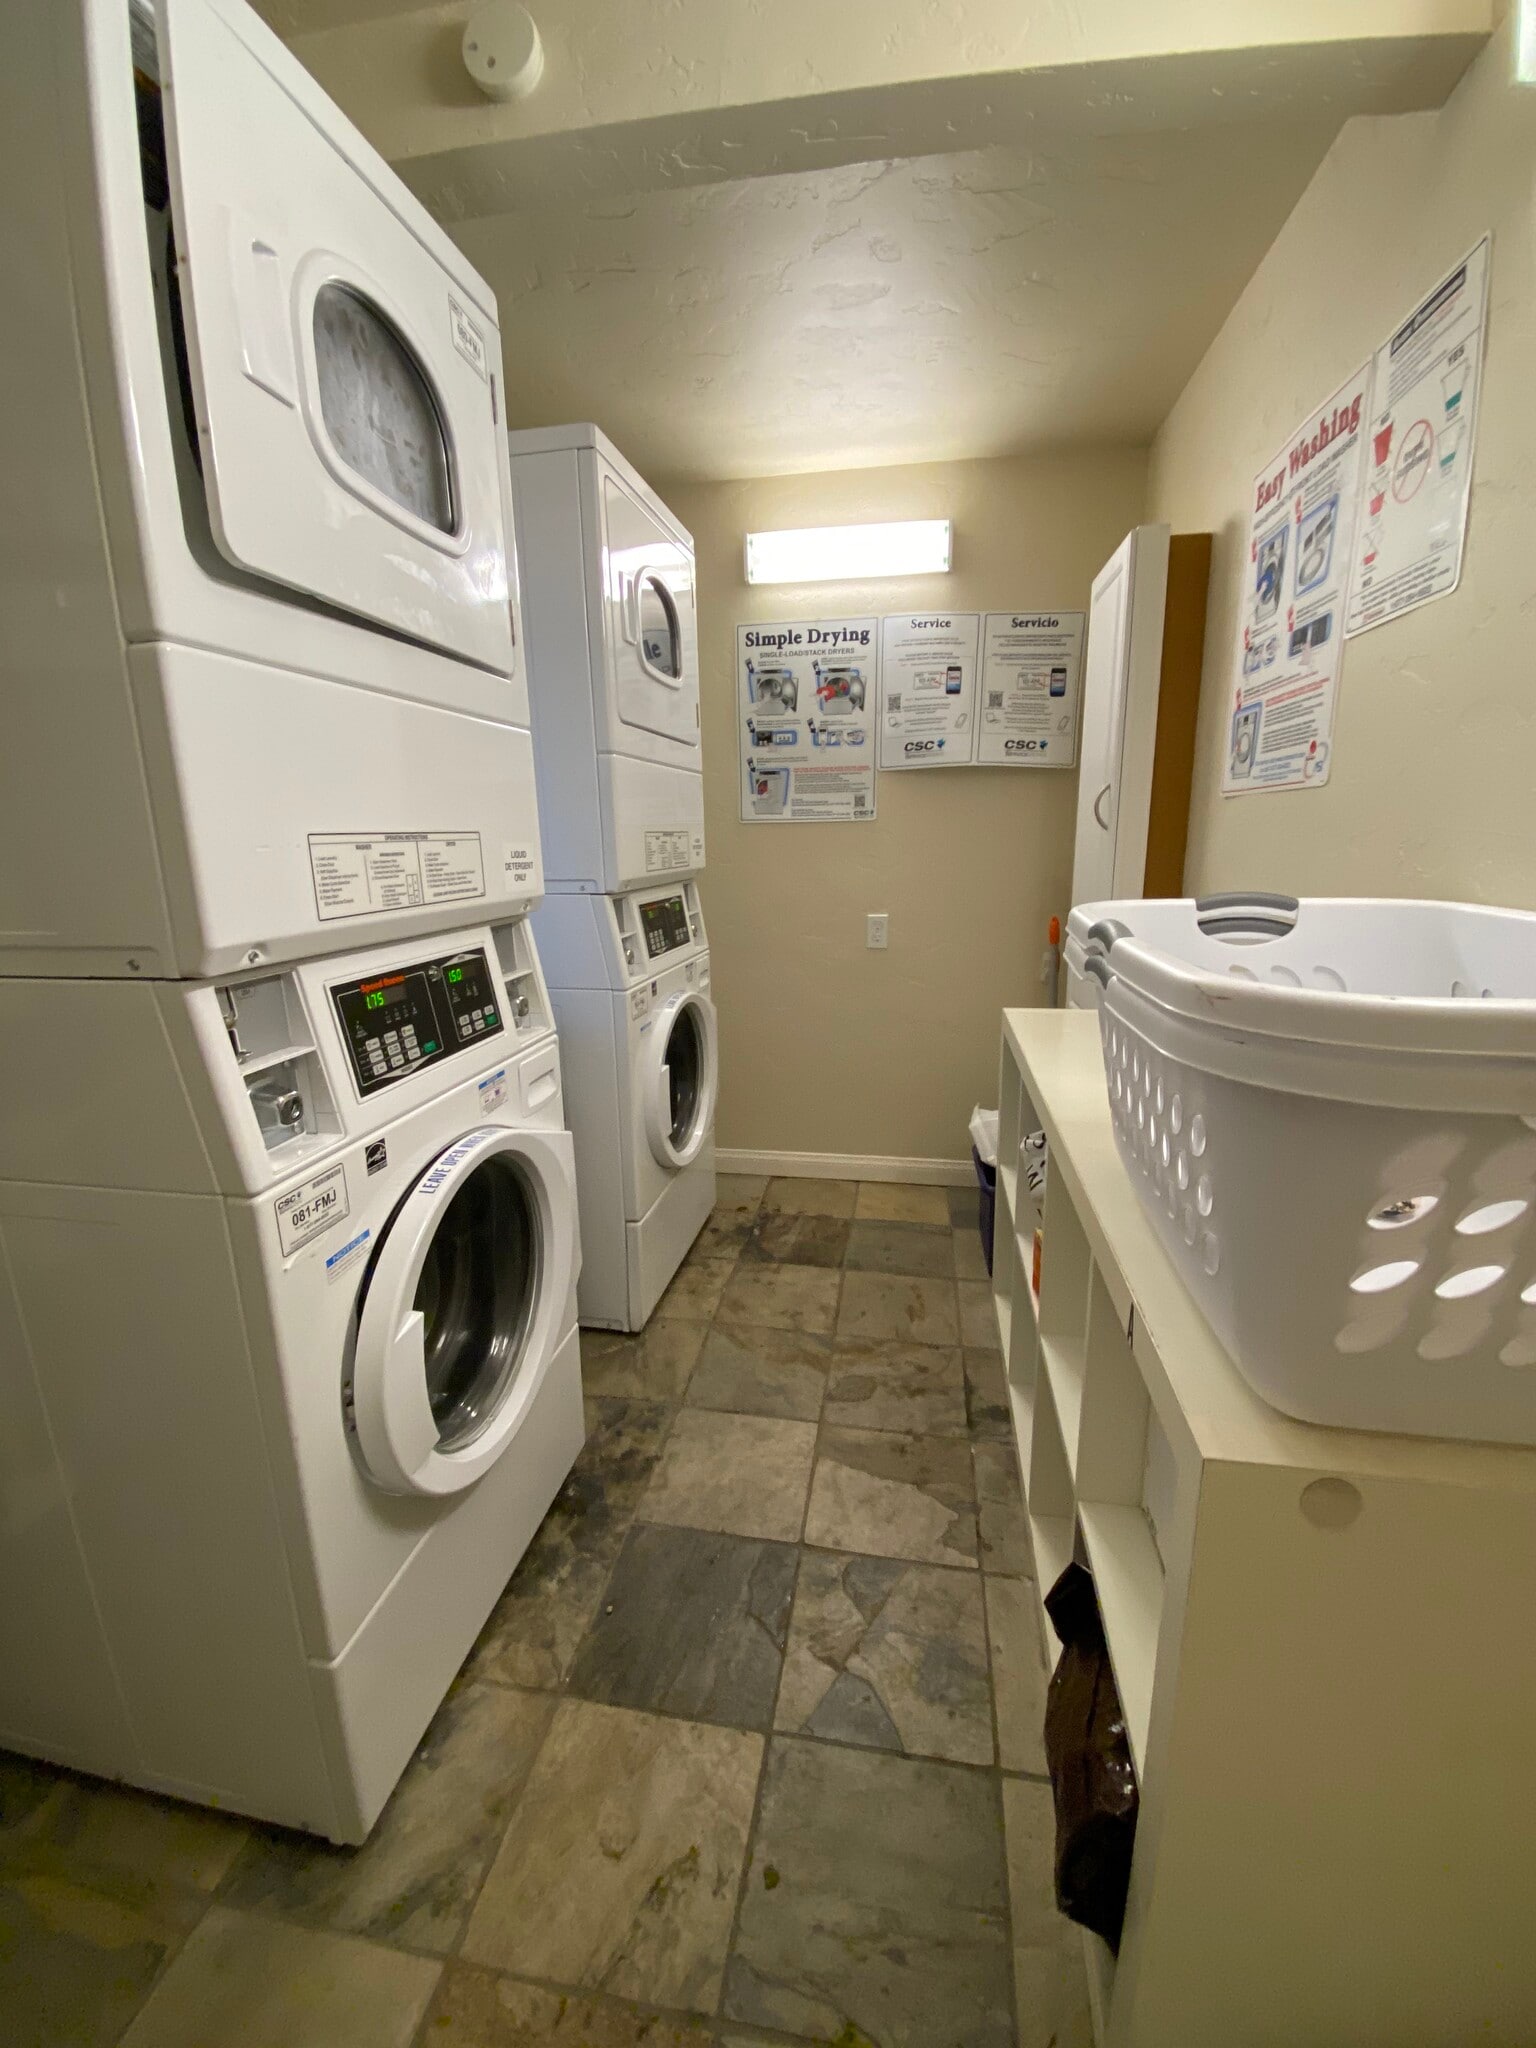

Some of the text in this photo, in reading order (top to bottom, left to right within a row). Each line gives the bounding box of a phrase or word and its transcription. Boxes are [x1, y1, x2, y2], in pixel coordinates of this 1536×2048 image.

[1256, 467, 1286, 513] Easy
[1289, 393, 1362, 478] Washing
[911, 618, 951, 629] Service
[1011, 617, 1059, 628] Servicio
[745, 627, 870, 650] Simple Drying
[828, 648, 855, 656] DRYERS
[904, 741, 935, 752] CSC
[1004, 740, 1037, 751] CSC
[510, 851, 526, 859] LIQUID
[505, 862, 534, 871] DETERGENT
[514, 873, 527, 882] ONLY
[419, 1168, 451, 1194] LEAVE
[440, 1149, 469, 1166] OPEN
[277, 1194, 296, 1210] CSC
[292, 1189, 337, 1226] 081-FMJ
[332, 1232, 364, 1263] NOTICE
